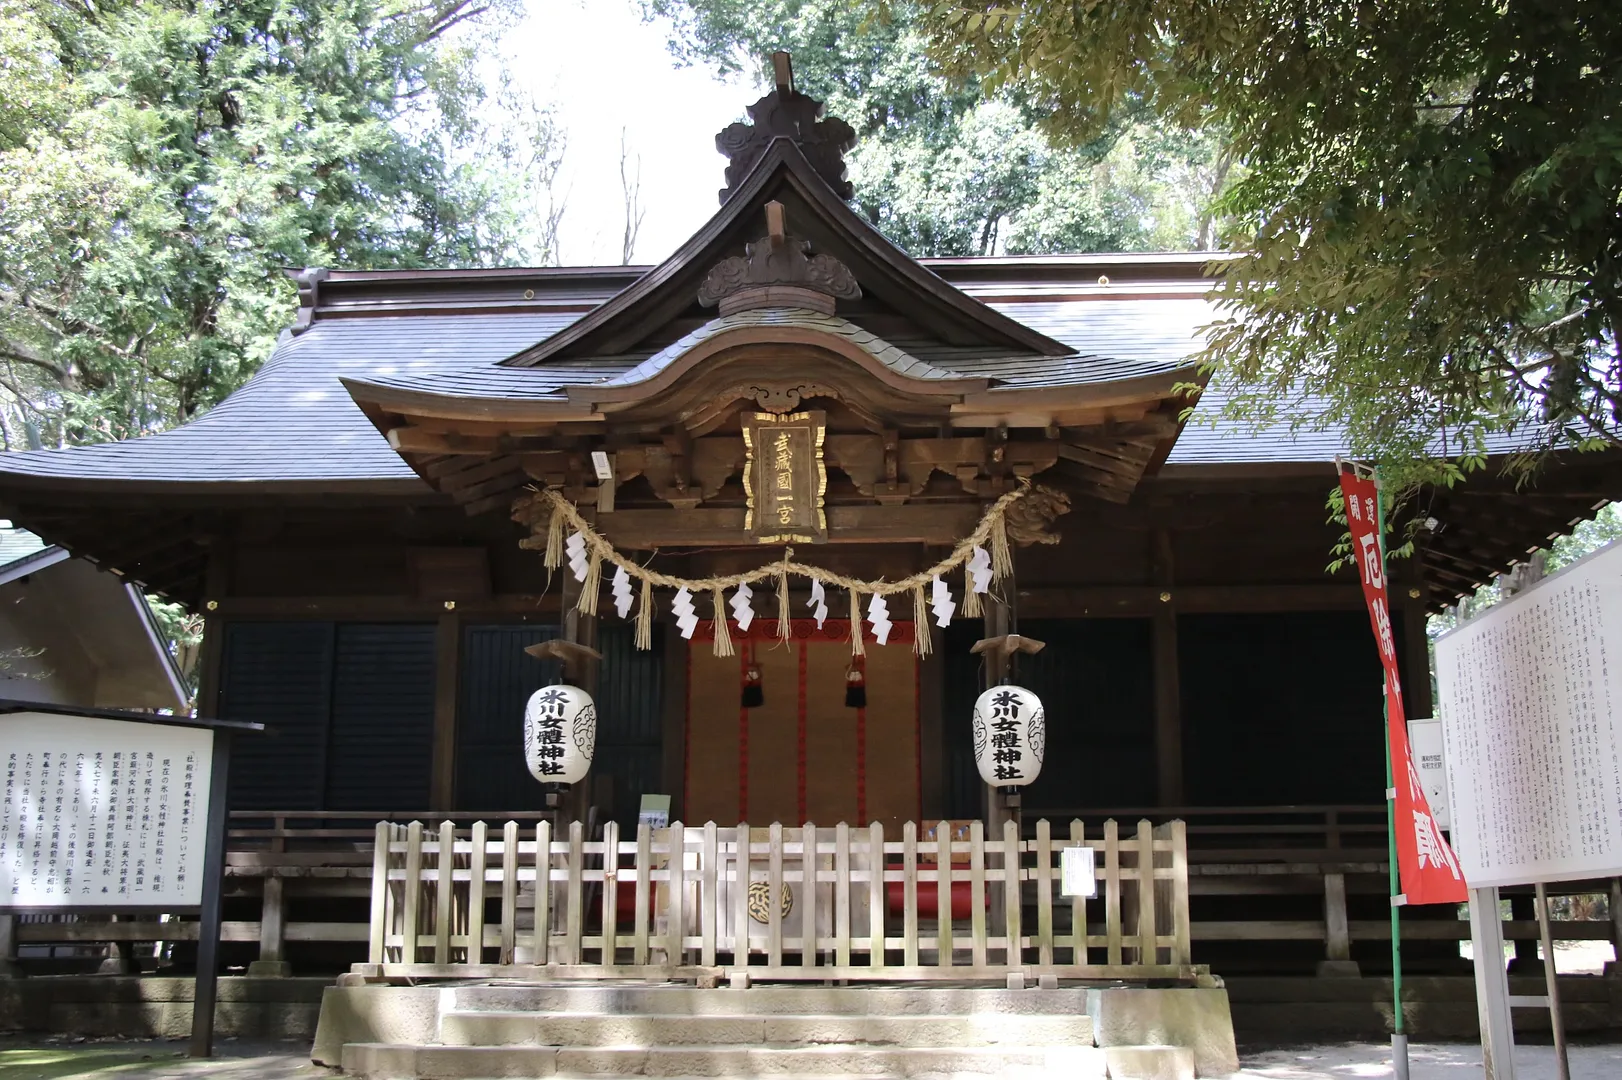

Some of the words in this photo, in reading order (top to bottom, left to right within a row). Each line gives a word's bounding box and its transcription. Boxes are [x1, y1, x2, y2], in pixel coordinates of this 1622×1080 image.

[536, 688, 570, 777] 氷川女體神社
[990, 690, 1024, 782] 氷川女體神社
